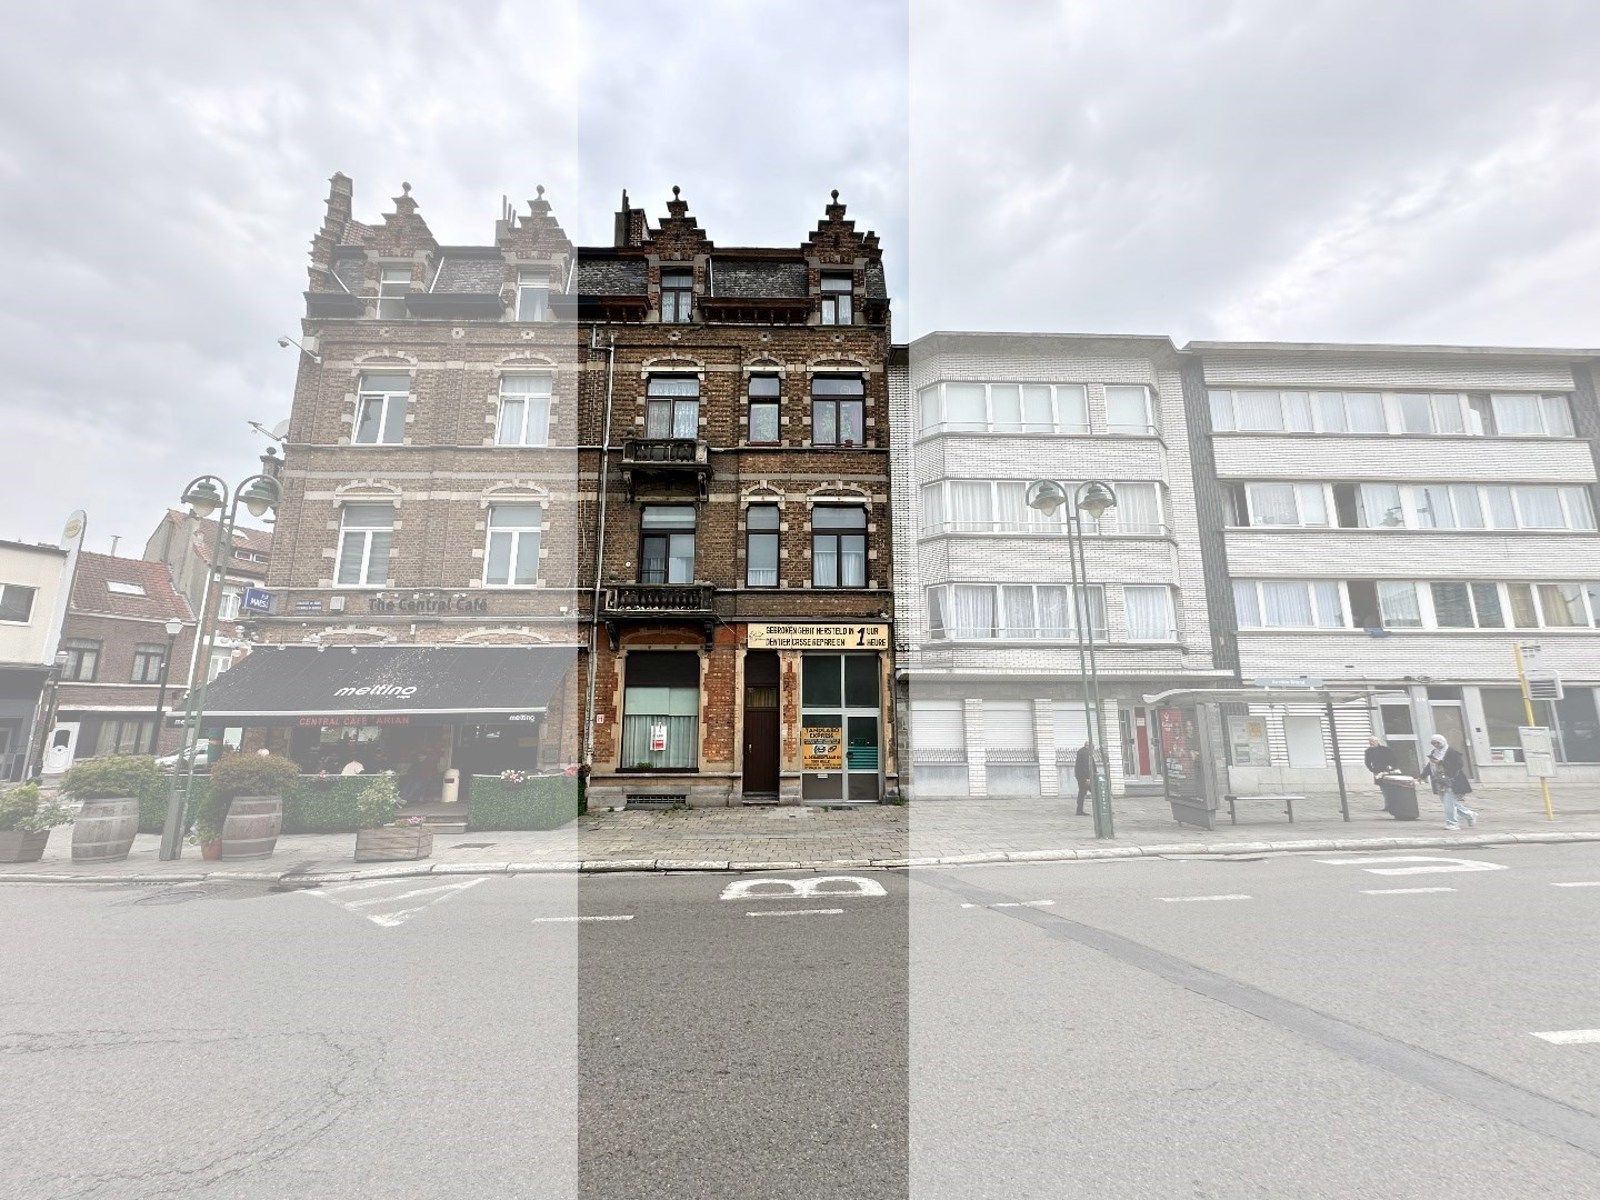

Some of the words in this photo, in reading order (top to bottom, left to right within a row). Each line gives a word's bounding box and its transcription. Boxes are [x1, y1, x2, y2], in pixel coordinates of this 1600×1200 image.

[369, 597, 394, 610] The
[399, 598, 451, 610] Central
[791, 638, 811, 646] CASSE
[867, 638, 886, 646] HEURE
[816, 627, 847, 635] HERSTELD
[856, 628, 865, 646] 1
[866, 627, 879, 635] UUR
[299, 716, 340, 726] CENTRAL
